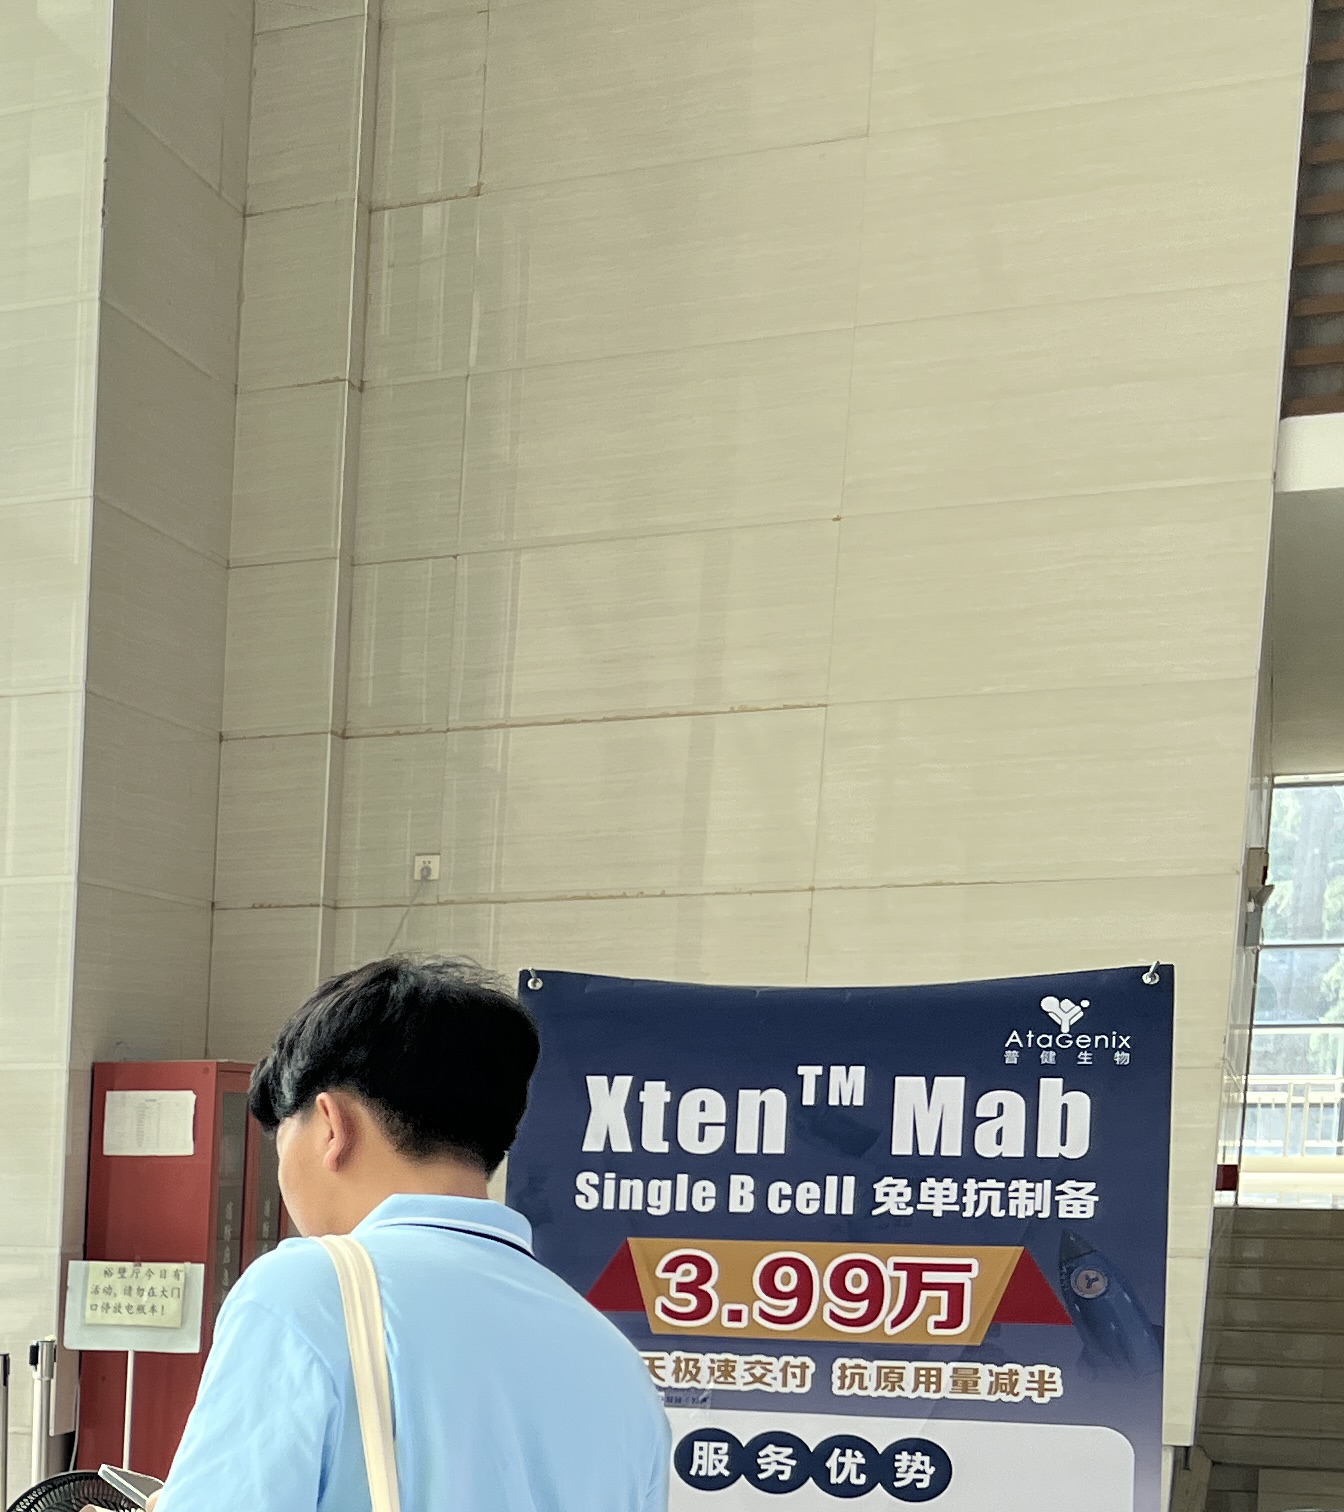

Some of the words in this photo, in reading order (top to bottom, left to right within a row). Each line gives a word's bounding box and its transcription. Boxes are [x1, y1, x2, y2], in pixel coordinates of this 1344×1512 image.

[1004, 1029, 1131, 1049] AtaGenix
[889, 1075, 1093, 1160] Mab
[573, 1170, 717, 1217] Single
[727, 1172, 758, 1214] B
[766, 1174, 856, 1216] cell
[870, 1175, 1101, 1220] 兔单抗制备
[653, 1247, 979, 1336] 3.99万
[832, 1362, 1064, 1404] 抗原用量减半
[688, 1440, 937, 1490] 服务优势
